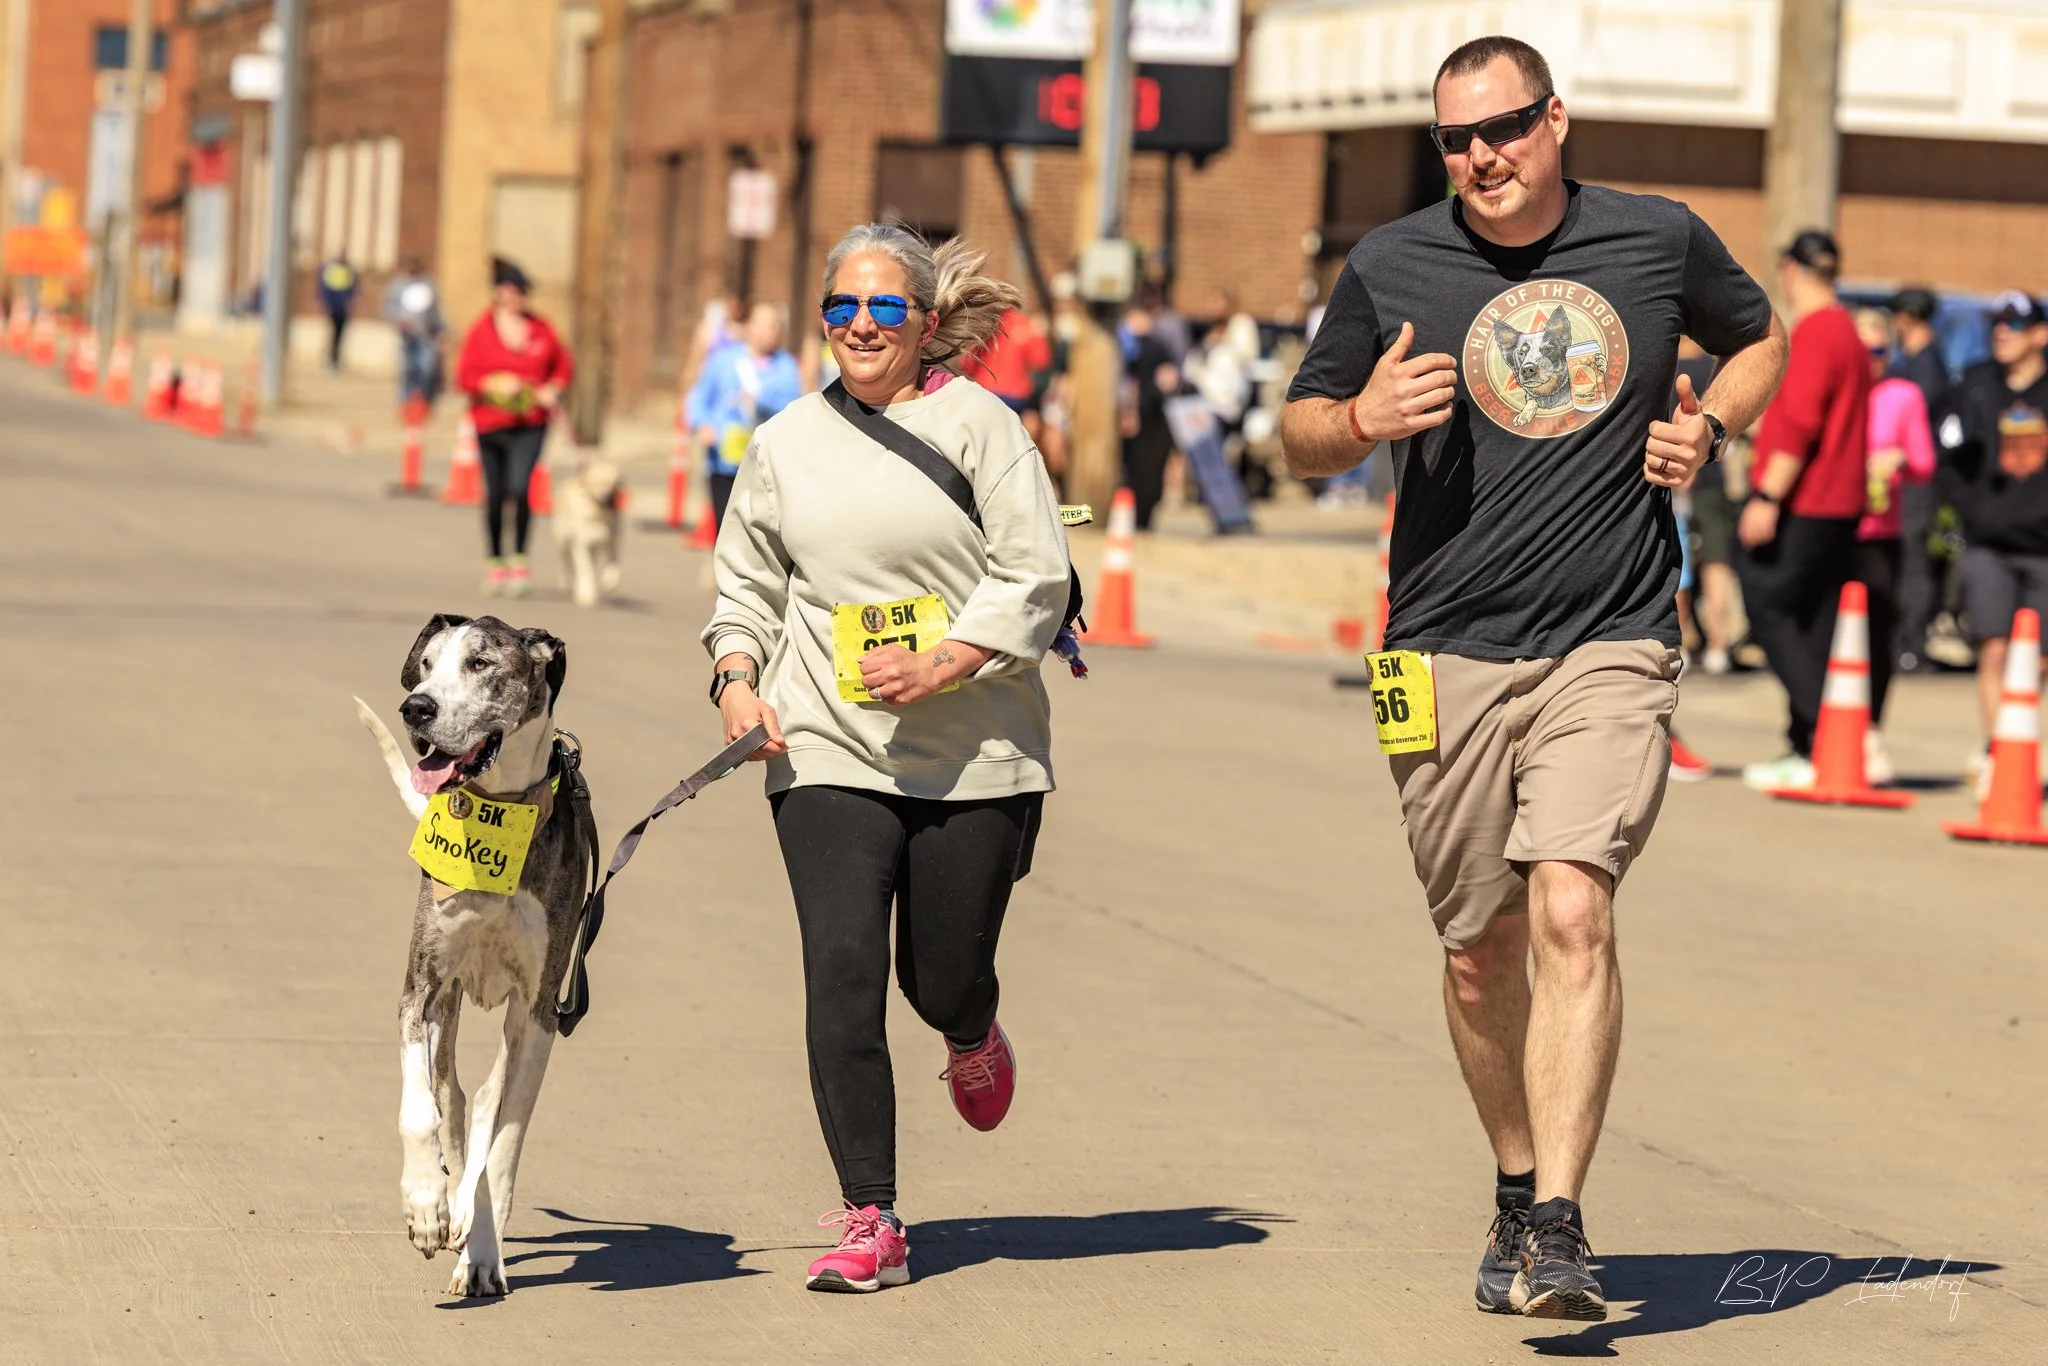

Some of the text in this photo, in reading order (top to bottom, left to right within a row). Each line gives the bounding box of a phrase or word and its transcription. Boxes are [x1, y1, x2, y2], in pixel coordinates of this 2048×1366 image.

[1469, 284, 1615, 350] HAIR OF THE DOG
[1473, 382, 1512, 425] BEER
[890, 603, 918, 627] 5K
[1377, 656, 1404, 679] 5K
[1371, 686, 1410, 726] 56
[477, 803, 507, 828] 5K
